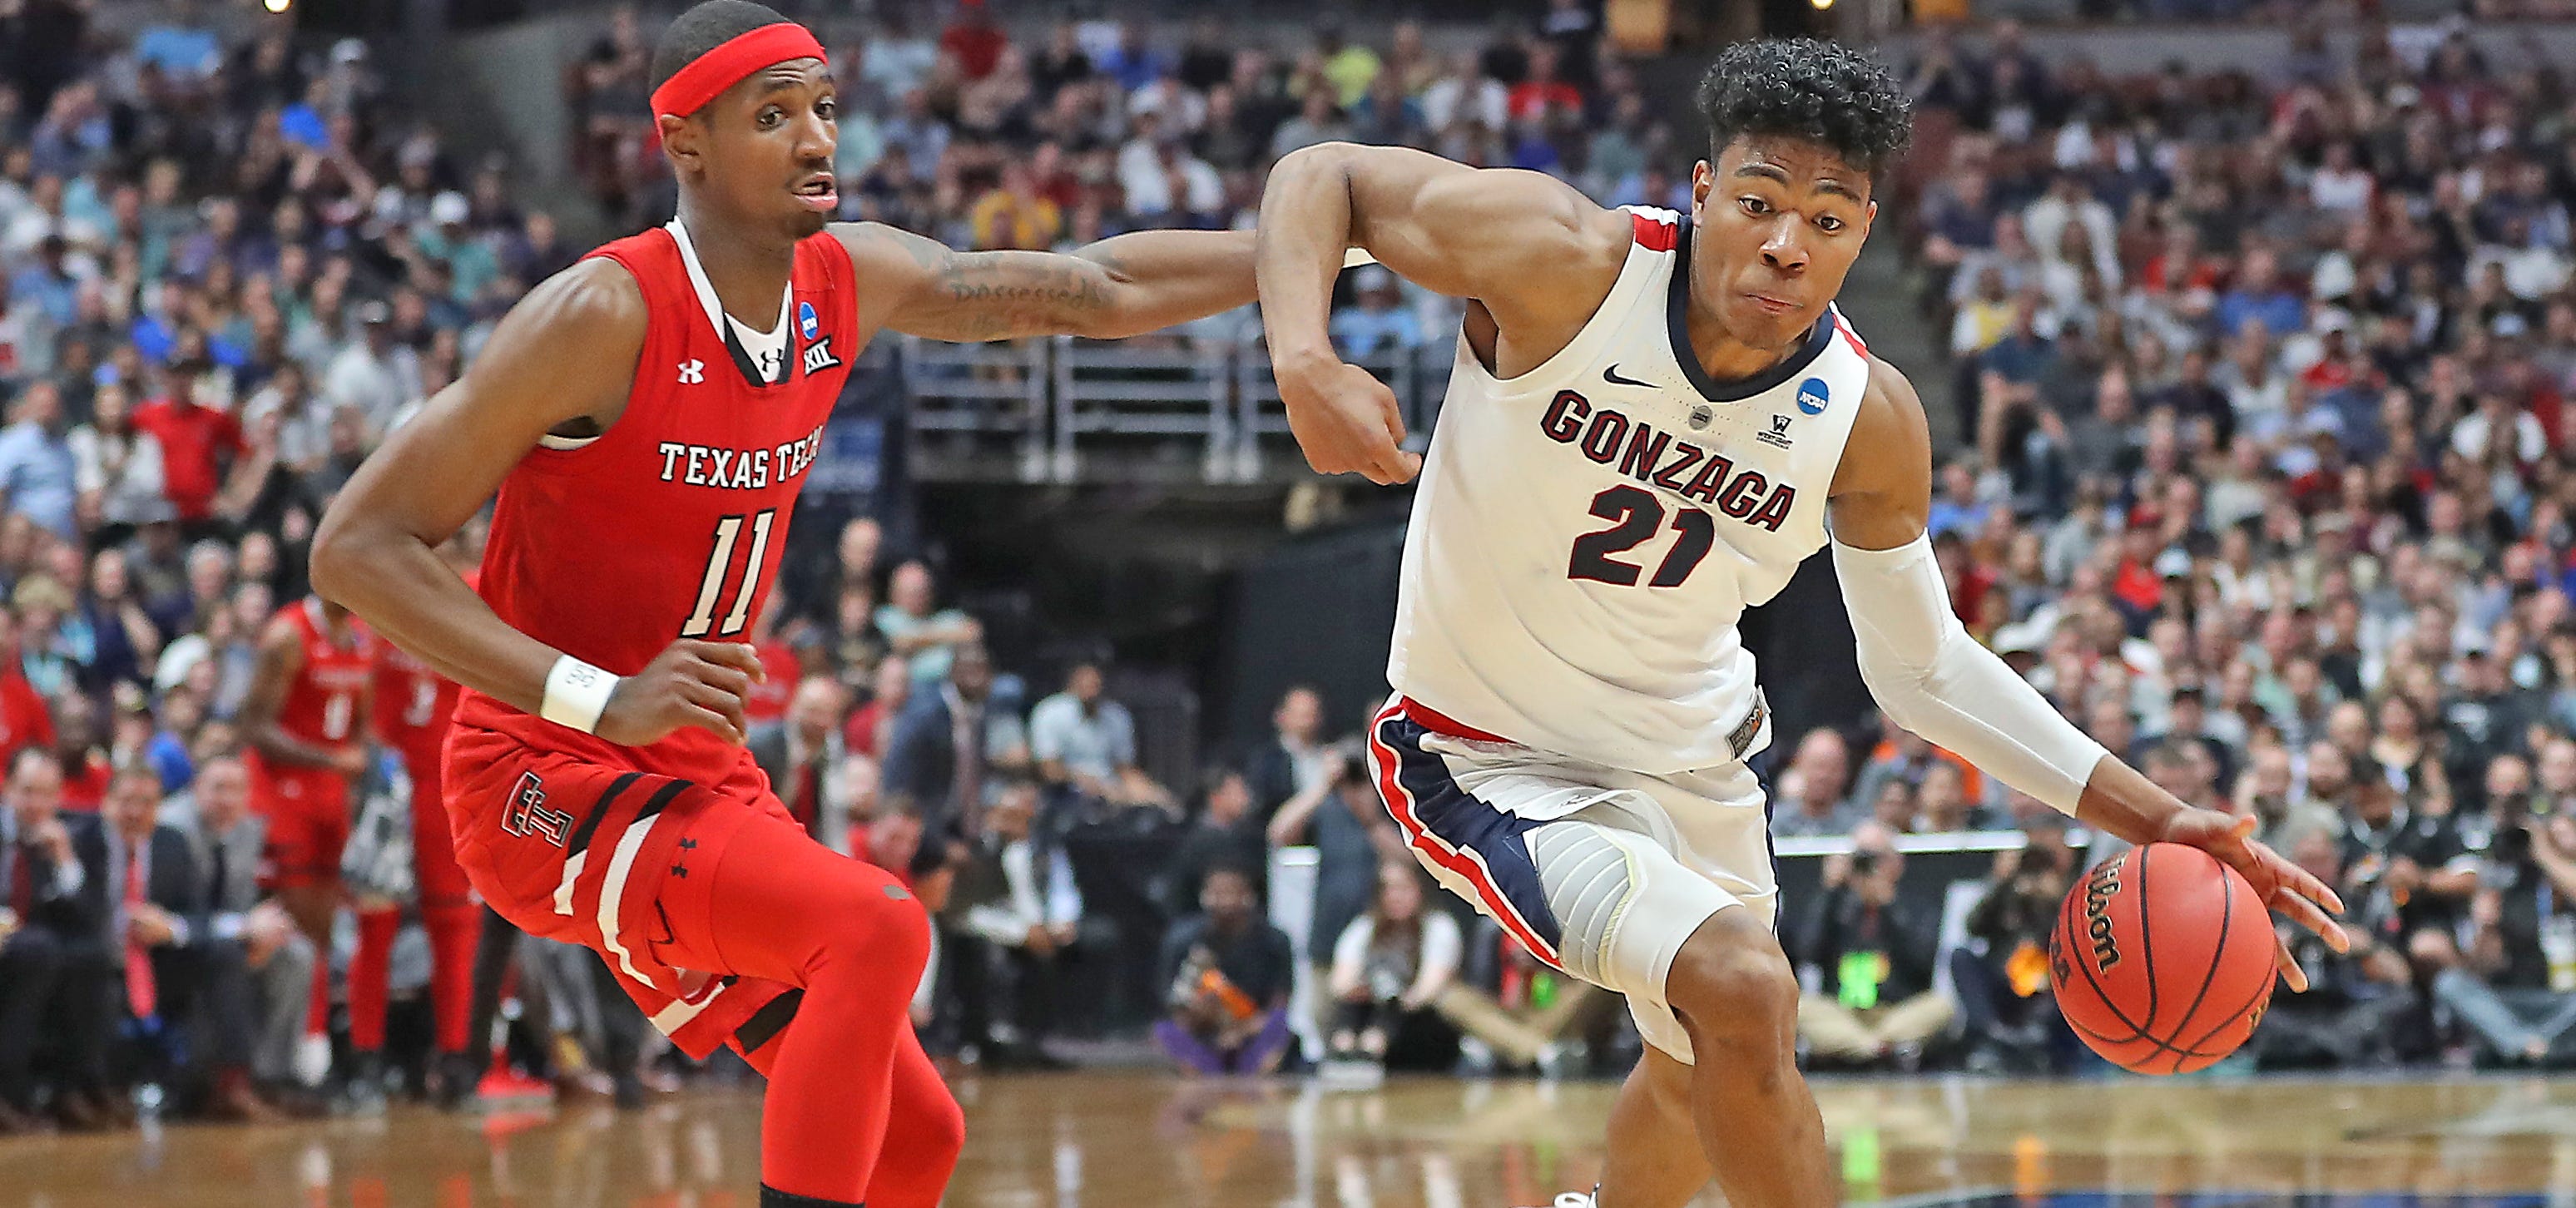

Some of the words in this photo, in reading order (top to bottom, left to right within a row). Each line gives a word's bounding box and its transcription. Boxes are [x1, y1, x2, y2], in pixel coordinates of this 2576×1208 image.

[659, 442, 770, 489] TEXAS
[1540, 389, 1796, 532] GONZAGA
[681, 507, 777, 638] 11
[1568, 483, 1716, 587] 21
